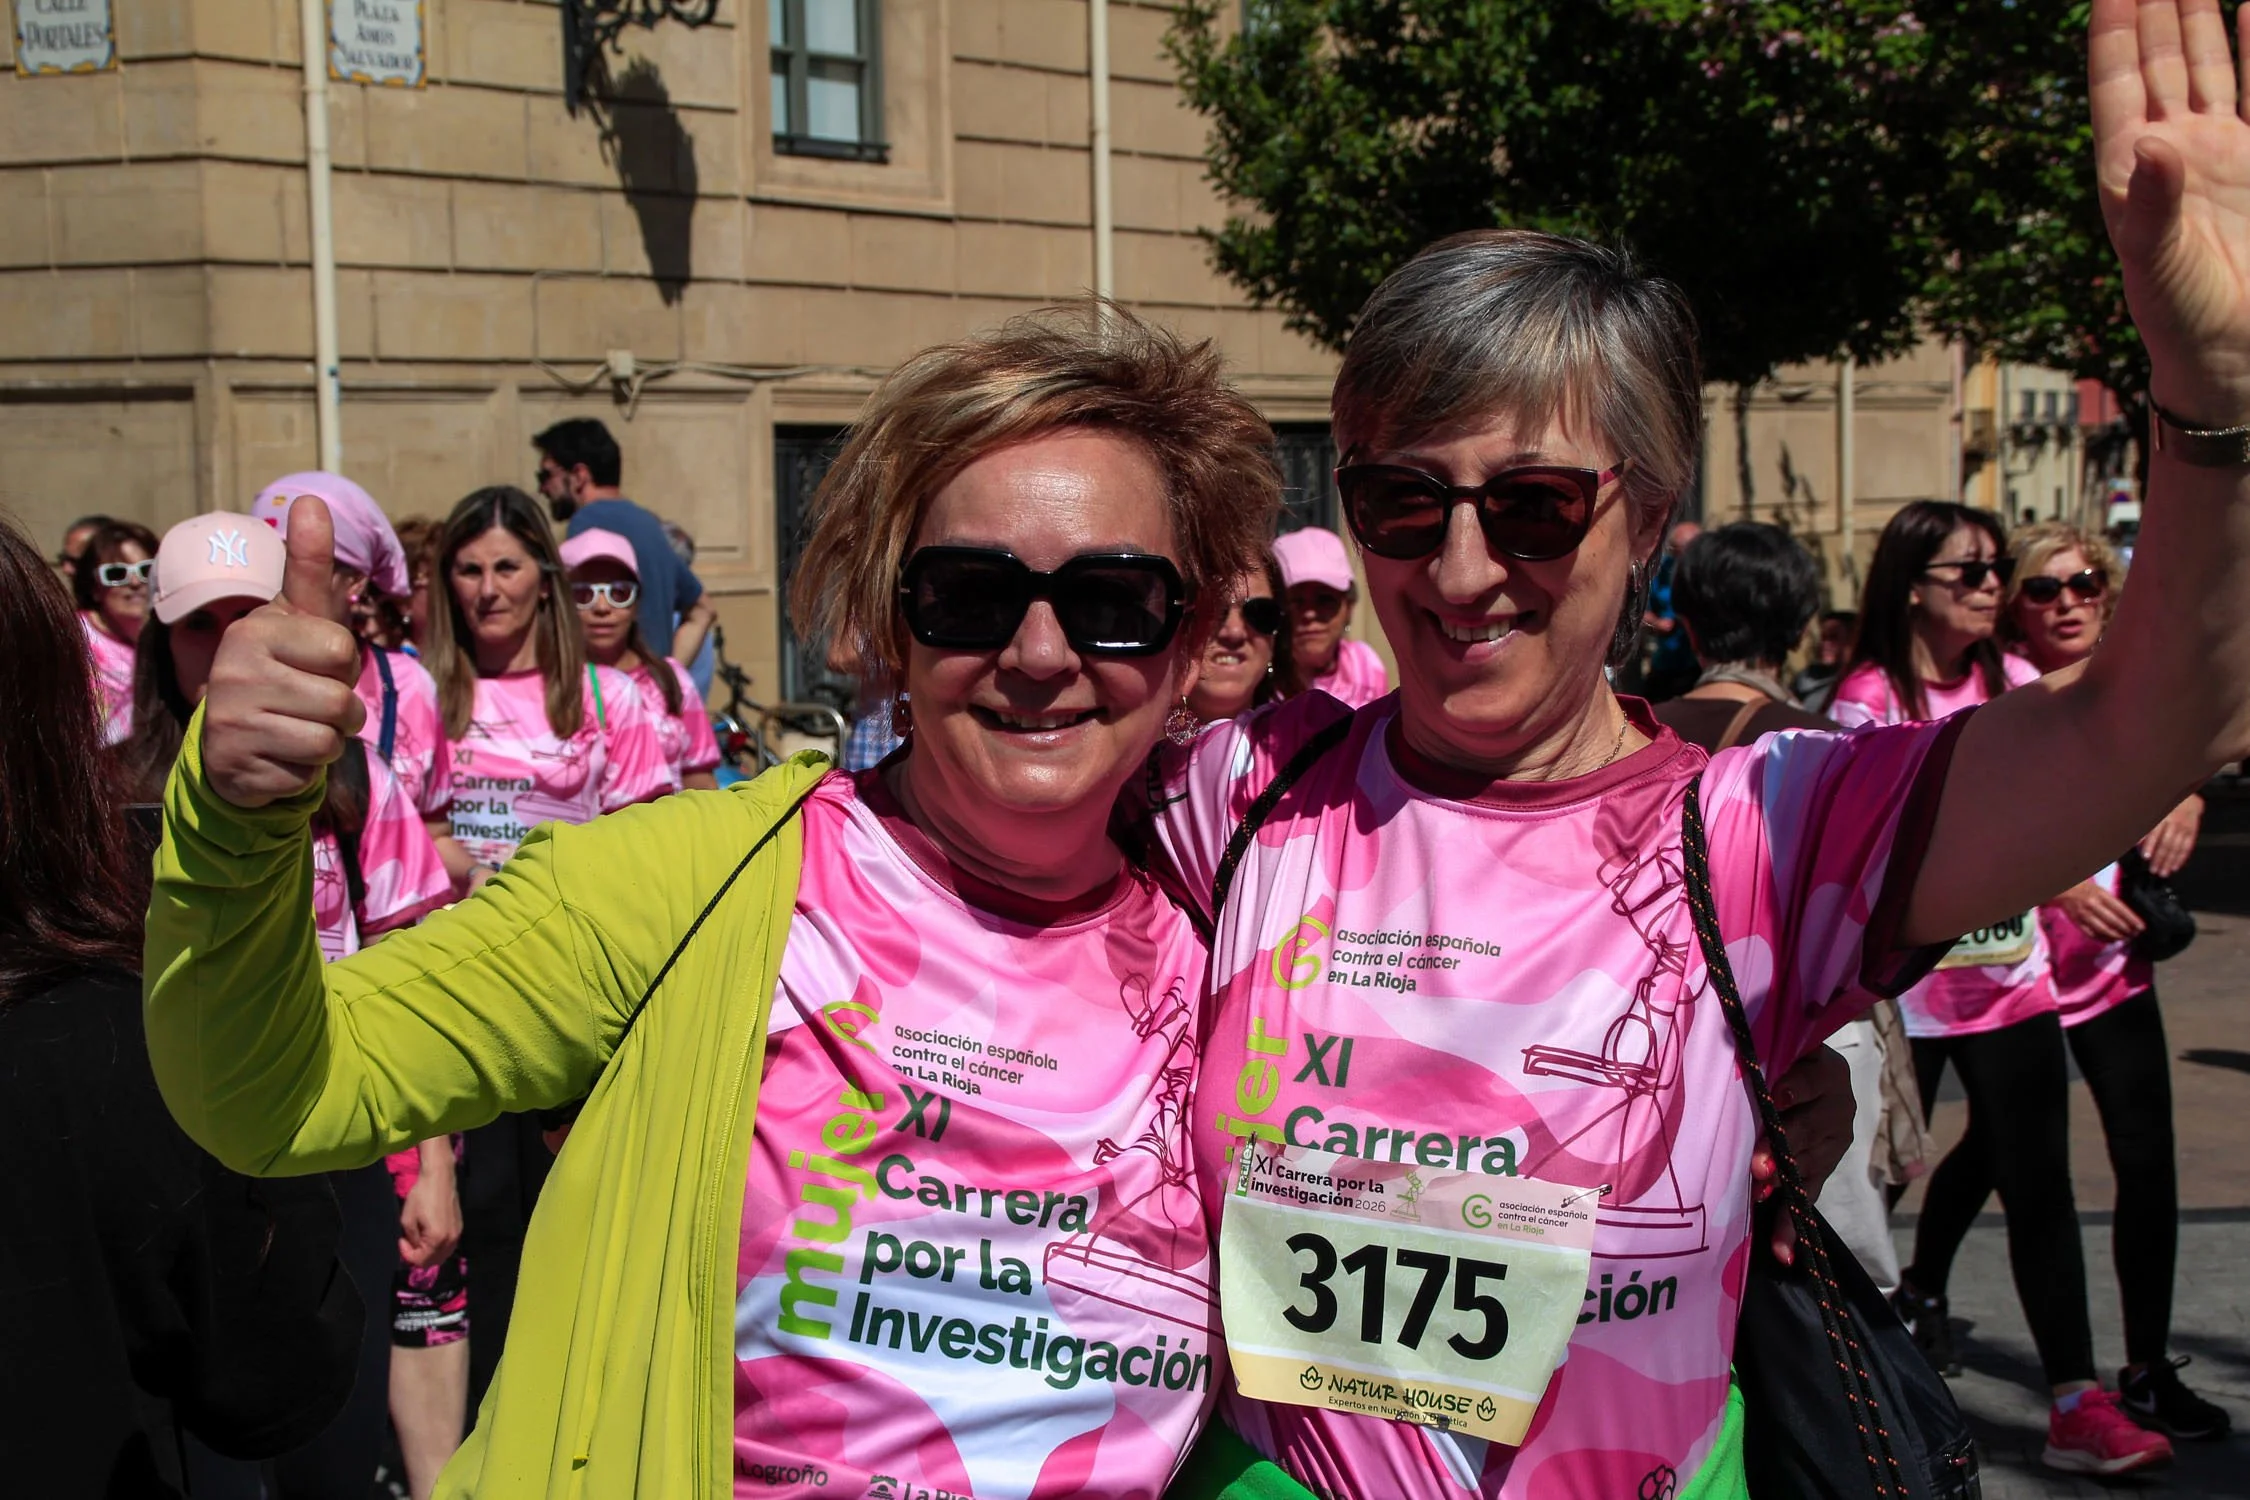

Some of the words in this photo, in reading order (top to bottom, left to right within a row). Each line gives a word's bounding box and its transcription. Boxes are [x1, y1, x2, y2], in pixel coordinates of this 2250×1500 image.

[26, 21, 106, 52] PORTALES
[451, 771, 531, 791] Carrera
[450, 797, 485, 817] por
[489, 796, 508, 815] la
[1332, 949, 1383, 966] contra
[1387, 952, 1404, 967] el
[1407, 953, 1461, 970] cáncer
[1337, 929, 1422, 947] asociación
[1425, 934, 1502, 957] española
[1327, 970, 1347, 985] en
[1351, 971, 1371, 987] La
[1374, 971, 1417, 994] Rioja
[892, 1045, 947, 1065] contra
[951, 1056, 965, 1070] el
[968, 1061, 1024, 1085] cáncer
[895, 1025, 982, 1054] asociación
[987, 1044, 1058, 1071] española
[1293, 1032, 1354, 1089] XI
[918, 1066, 938, 1082] La
[942, 1071, 982, 1095] Rioja
[1215, 1016, 1290, 1165] jer
[892, 1083, 952, 1143] XI
[1284, 1105, 1518, 1178] Carrera
[1254, 1154, 1273, 1175] XI
[1276, 1165, 1333, 1187] Carrera
[1336, 1178, 1366, 1192] por
[1368, 1179, 1384, 1194] la
[778, 1074, 885, 1341] mujer
[876, 1153, 1089, 1234] Carrera
[1250, 1177, 1353, 1209] investigación
[1355, 1199, 1386, 1213] 2026
[1499, 1202, 1546, 1214] asociación
[1547, 1208, 1588, 1220] española
[1497, 1222, 1508, 1230] en
[1510, 1223, 1521, 1232] La
[1523, 1224, 1545, 1236] Rioja
[1498, 1212, 1527, 1222] contra
[1528, 1215, 1537, 1223] el
[1538, 1217, 1568, 1228] cáncer
[859, 1230, 966, 1285] por
[979, 1238, 1033, 1296] la
[1282, 1232, 1509, 1361] 3175
[848, 1291, 1214, 1393] Investigación
[1328, 1374, 1398, 1402] NATUR
[1402, 1387, 1473, 1414] HOUSE
[1328, 1396, 1367, 1411] Expertos
[1368, 1404, 1379, 1413] en
[1422, 1413, 1427, 1423] y
[740, 1457, 829, 1487] Logroño
